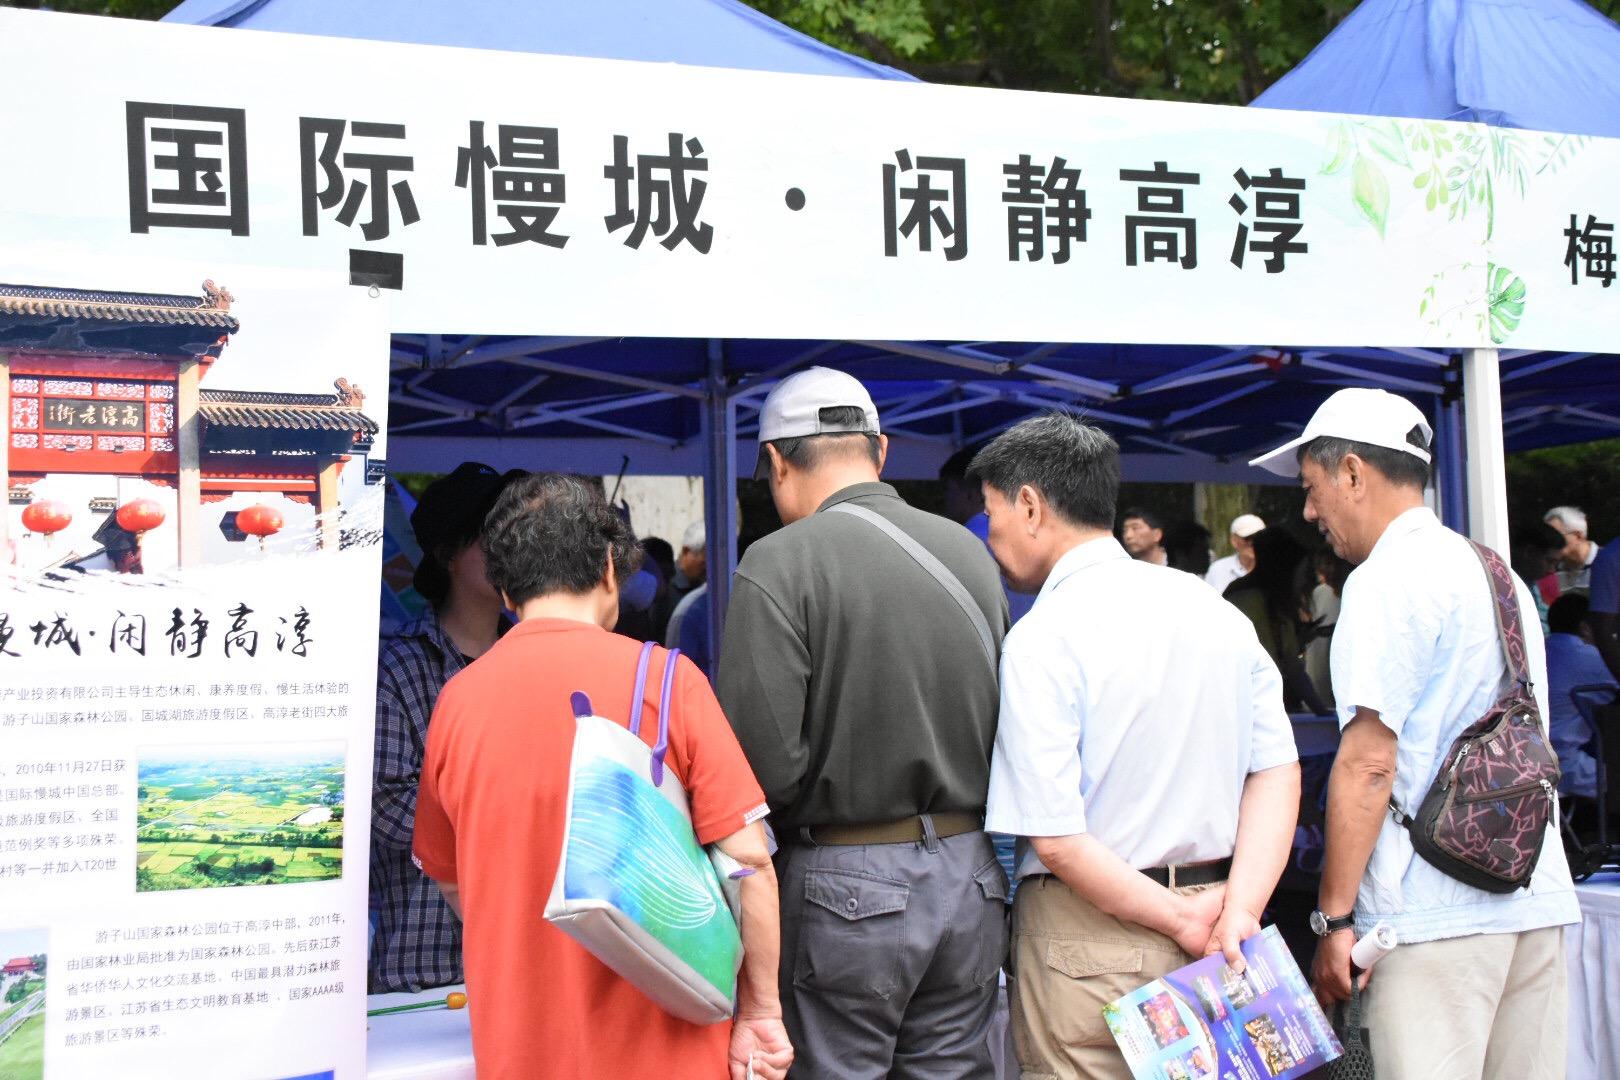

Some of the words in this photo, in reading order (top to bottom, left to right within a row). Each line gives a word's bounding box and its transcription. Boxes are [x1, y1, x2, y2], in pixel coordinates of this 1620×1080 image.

[125, 101, 1308, 274] 国际慢城·闲静高淳
[1563, 213, 1618, 287] 梅
[0, 681, 349, 702] 产业投资有限公司主导生态休闲、康养度假、慢生活体验的
